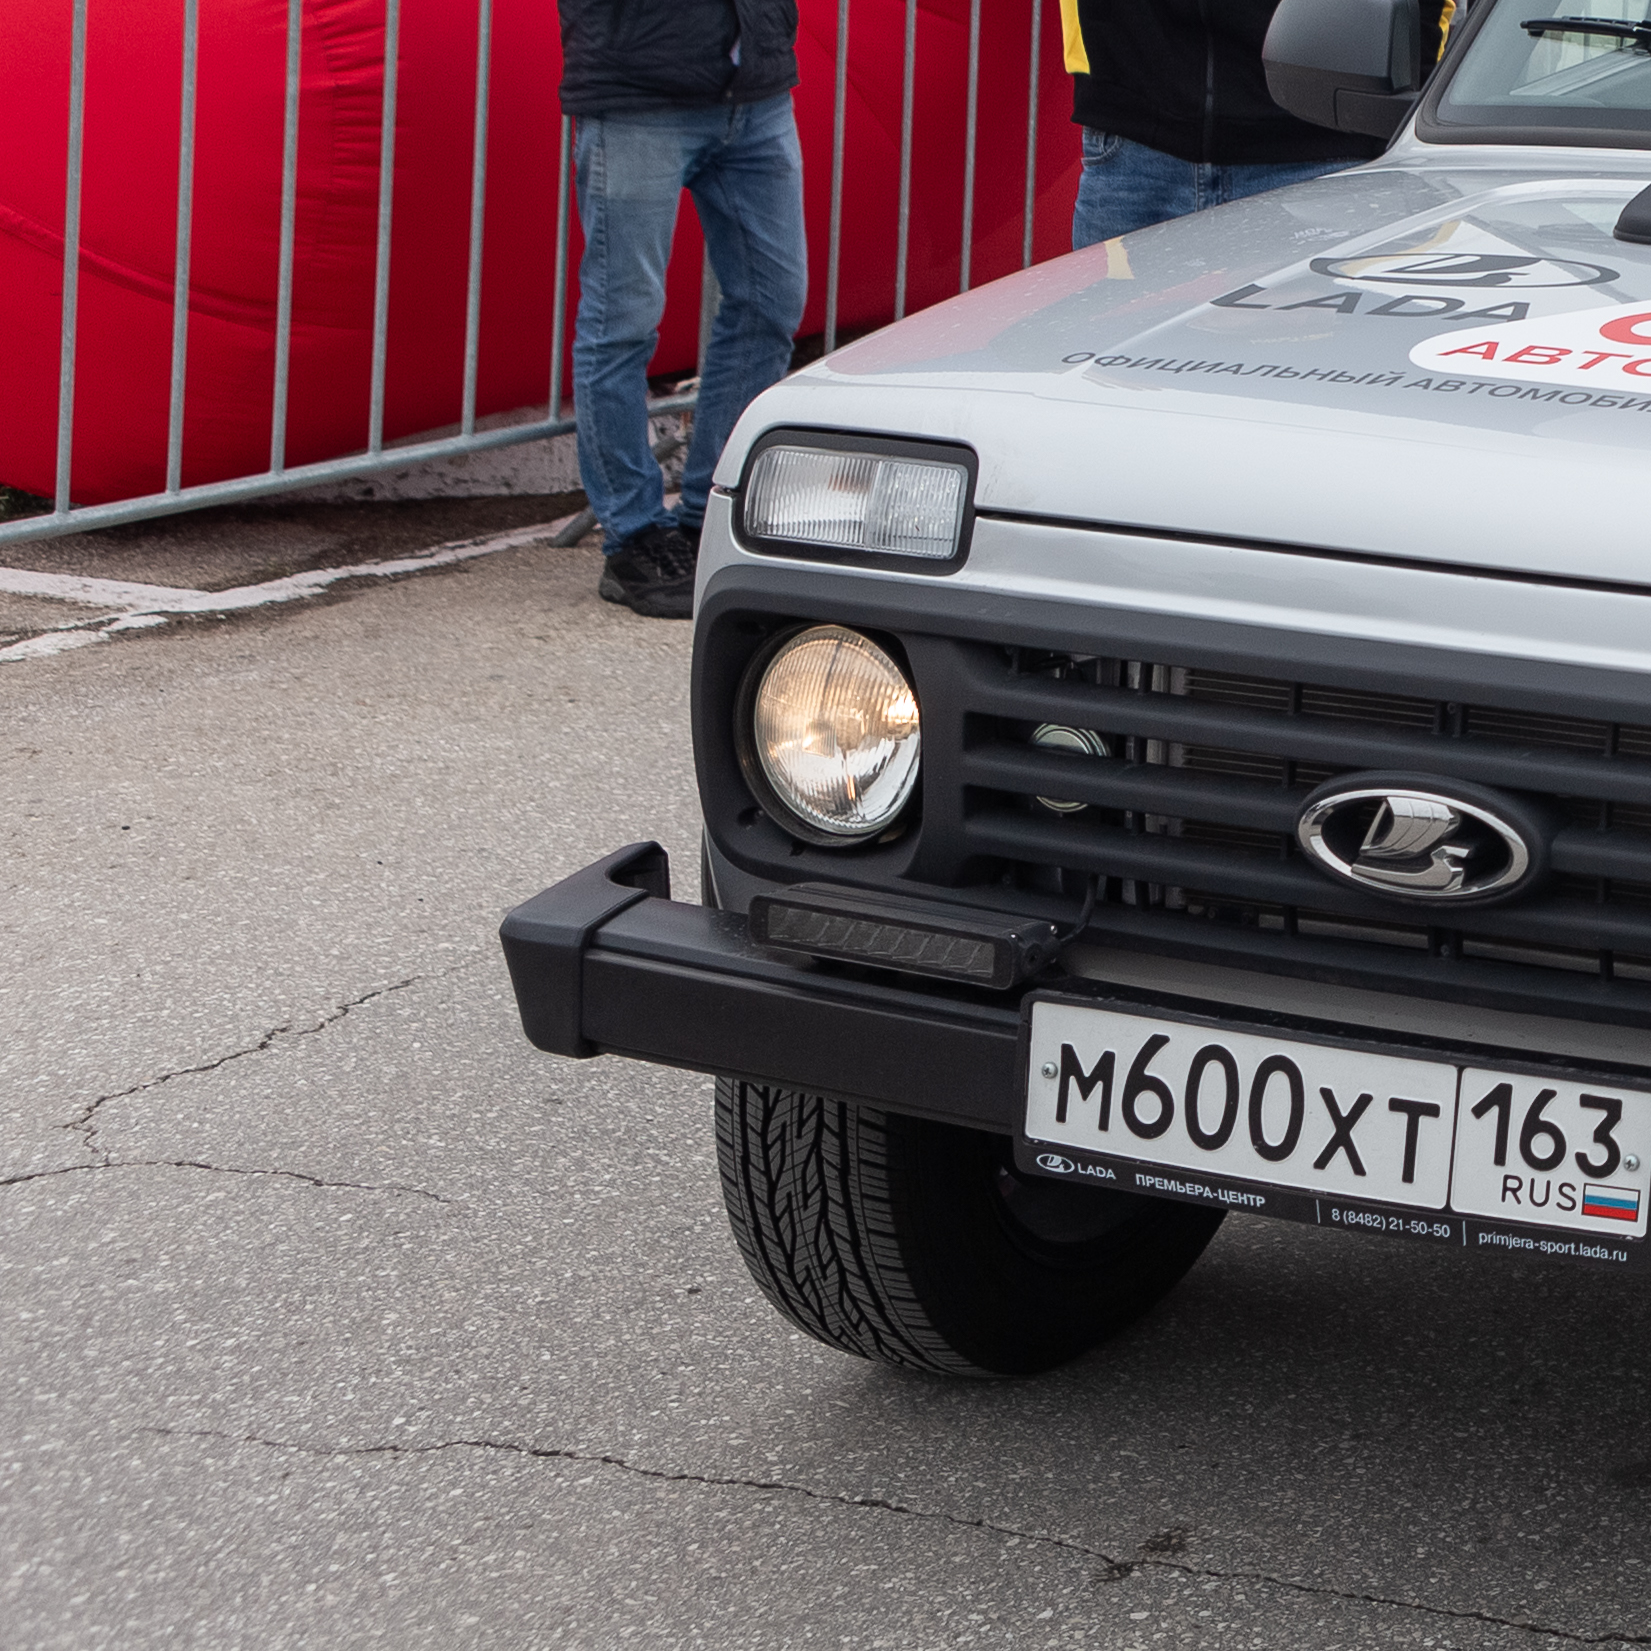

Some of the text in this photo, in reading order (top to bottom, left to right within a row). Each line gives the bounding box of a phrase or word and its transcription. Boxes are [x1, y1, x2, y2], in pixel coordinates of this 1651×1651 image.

[1209, 283, 1531, 323] LADA
[1061, 351, 1406, 388] ОФИЦИАЛЬНЫЙ
[1054, 1032, 1624, 1185] М600ХТ 163
[1077, 1162, 1266, 1208] LADA ПРЕМЬЕРА-ЦЕНТР
[1501, 1174, 1578, 1212] RUS
[1331, 1208, 1451, 1238] 8 (8482) 21-50-50
